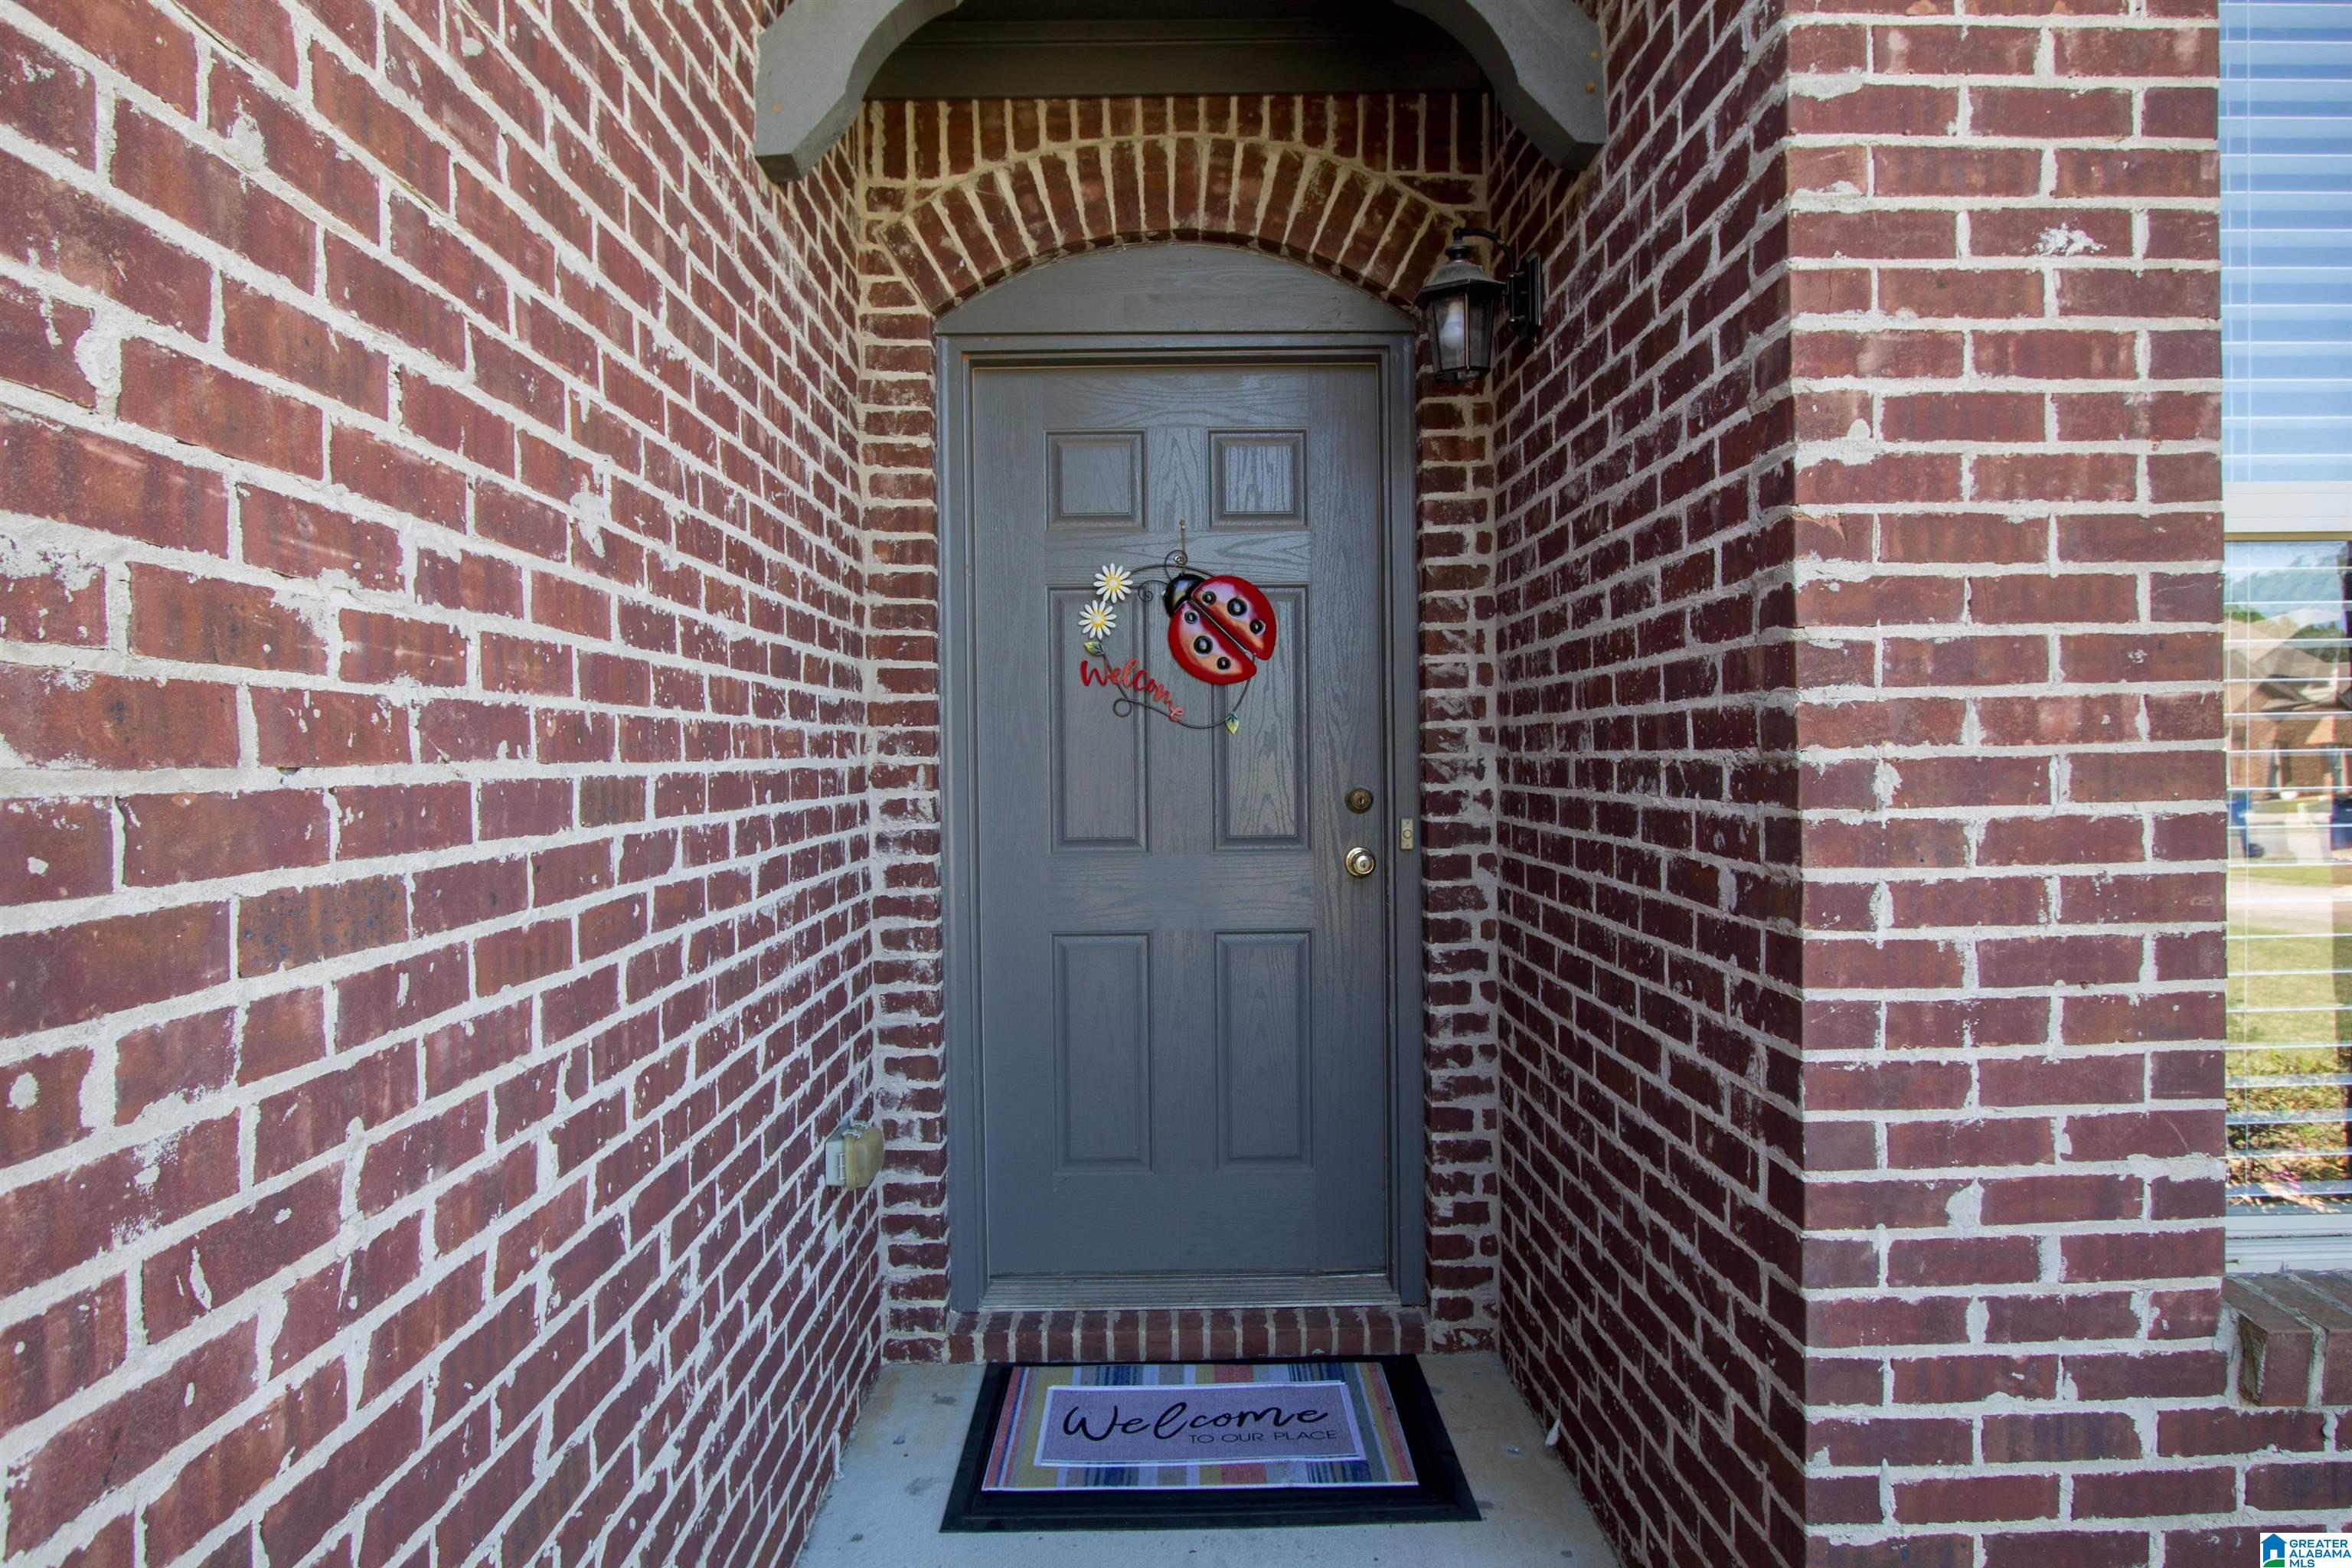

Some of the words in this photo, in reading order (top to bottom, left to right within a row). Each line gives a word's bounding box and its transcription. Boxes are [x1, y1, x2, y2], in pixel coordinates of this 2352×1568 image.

[1080, 658, 1184, 723] Welcome
[1063, 1402, 1329, 1441] Welcome
[1189, 1434, 1213, 1444] TO
[1221, 1432, 1264, 1443] OUR
[1274, 1429, 1338, 1440] PLACE
